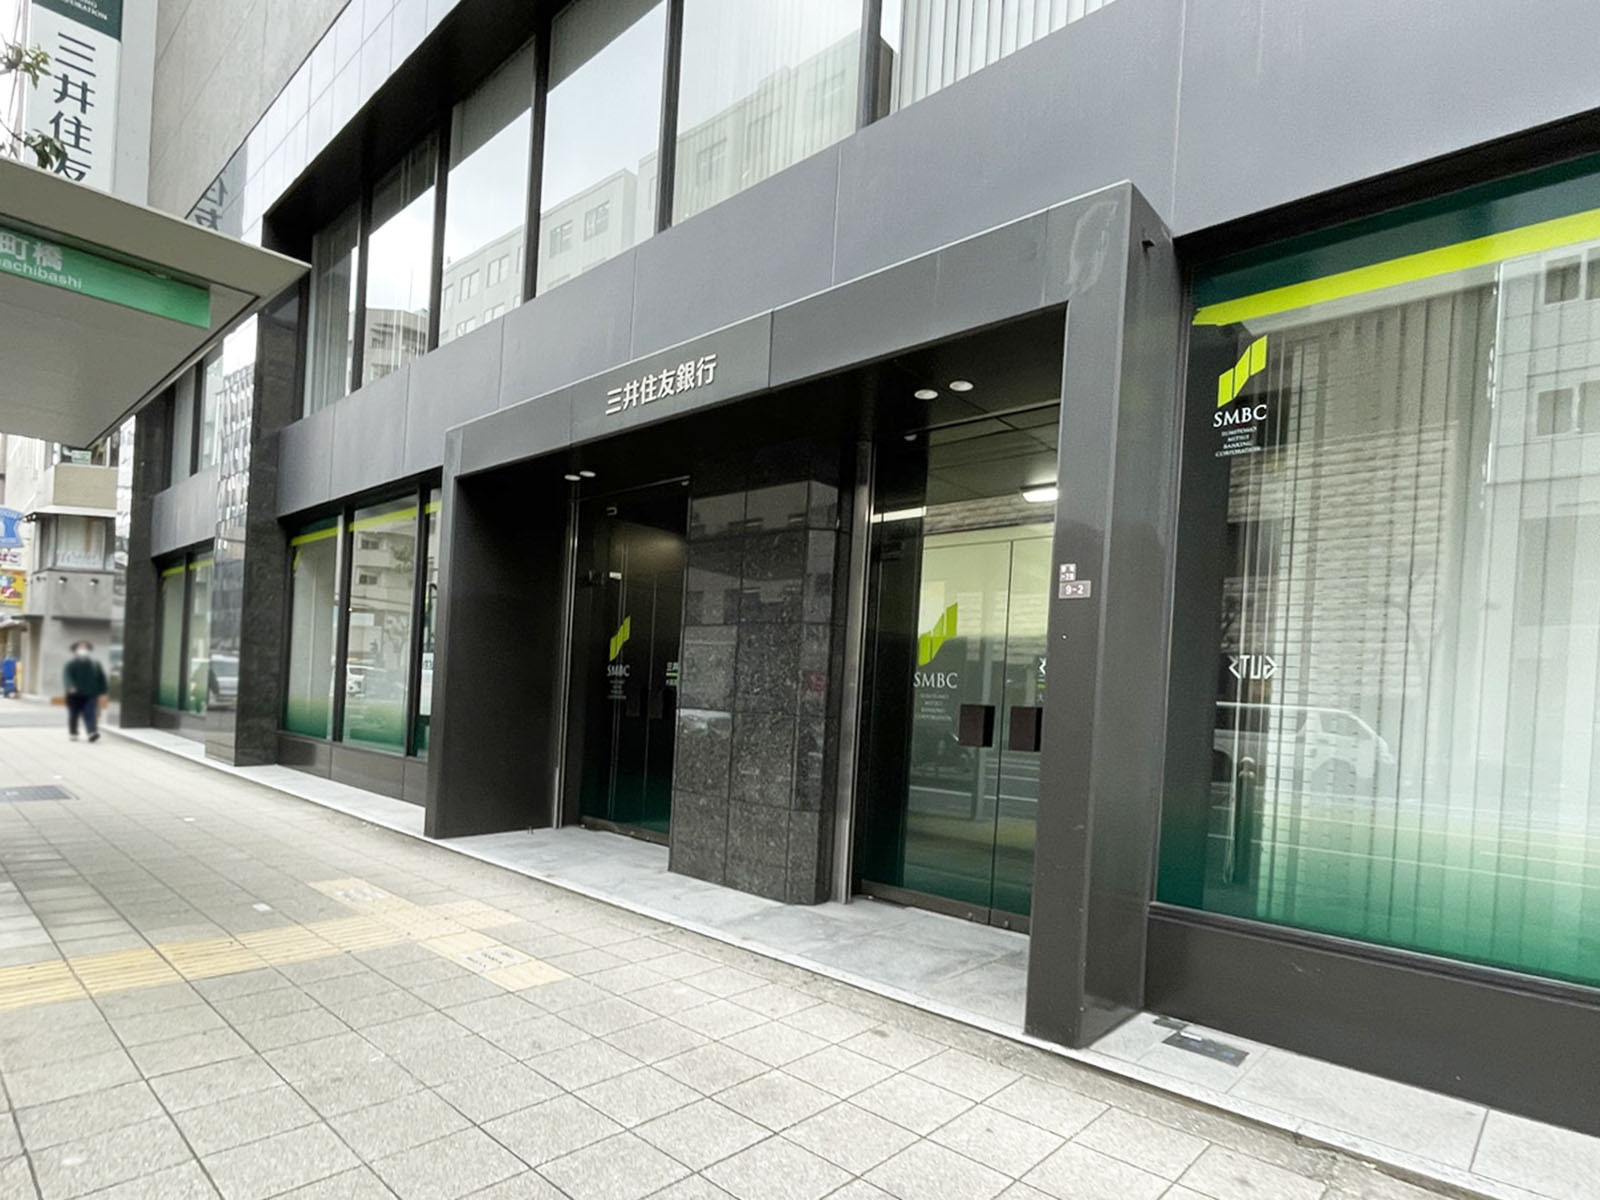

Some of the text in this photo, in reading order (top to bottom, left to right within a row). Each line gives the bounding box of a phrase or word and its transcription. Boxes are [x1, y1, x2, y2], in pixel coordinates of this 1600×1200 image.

[0, 258, 83, 290] achibashi
[605, 353, 717, 416] 三井住友銀行
[1212, 404, 1268, 428] SMBC
[1065, 584, 1084, 595] 9-2
[606, 664, 630, 678] SMBC
[913, 672, 958, 689] SMBC
